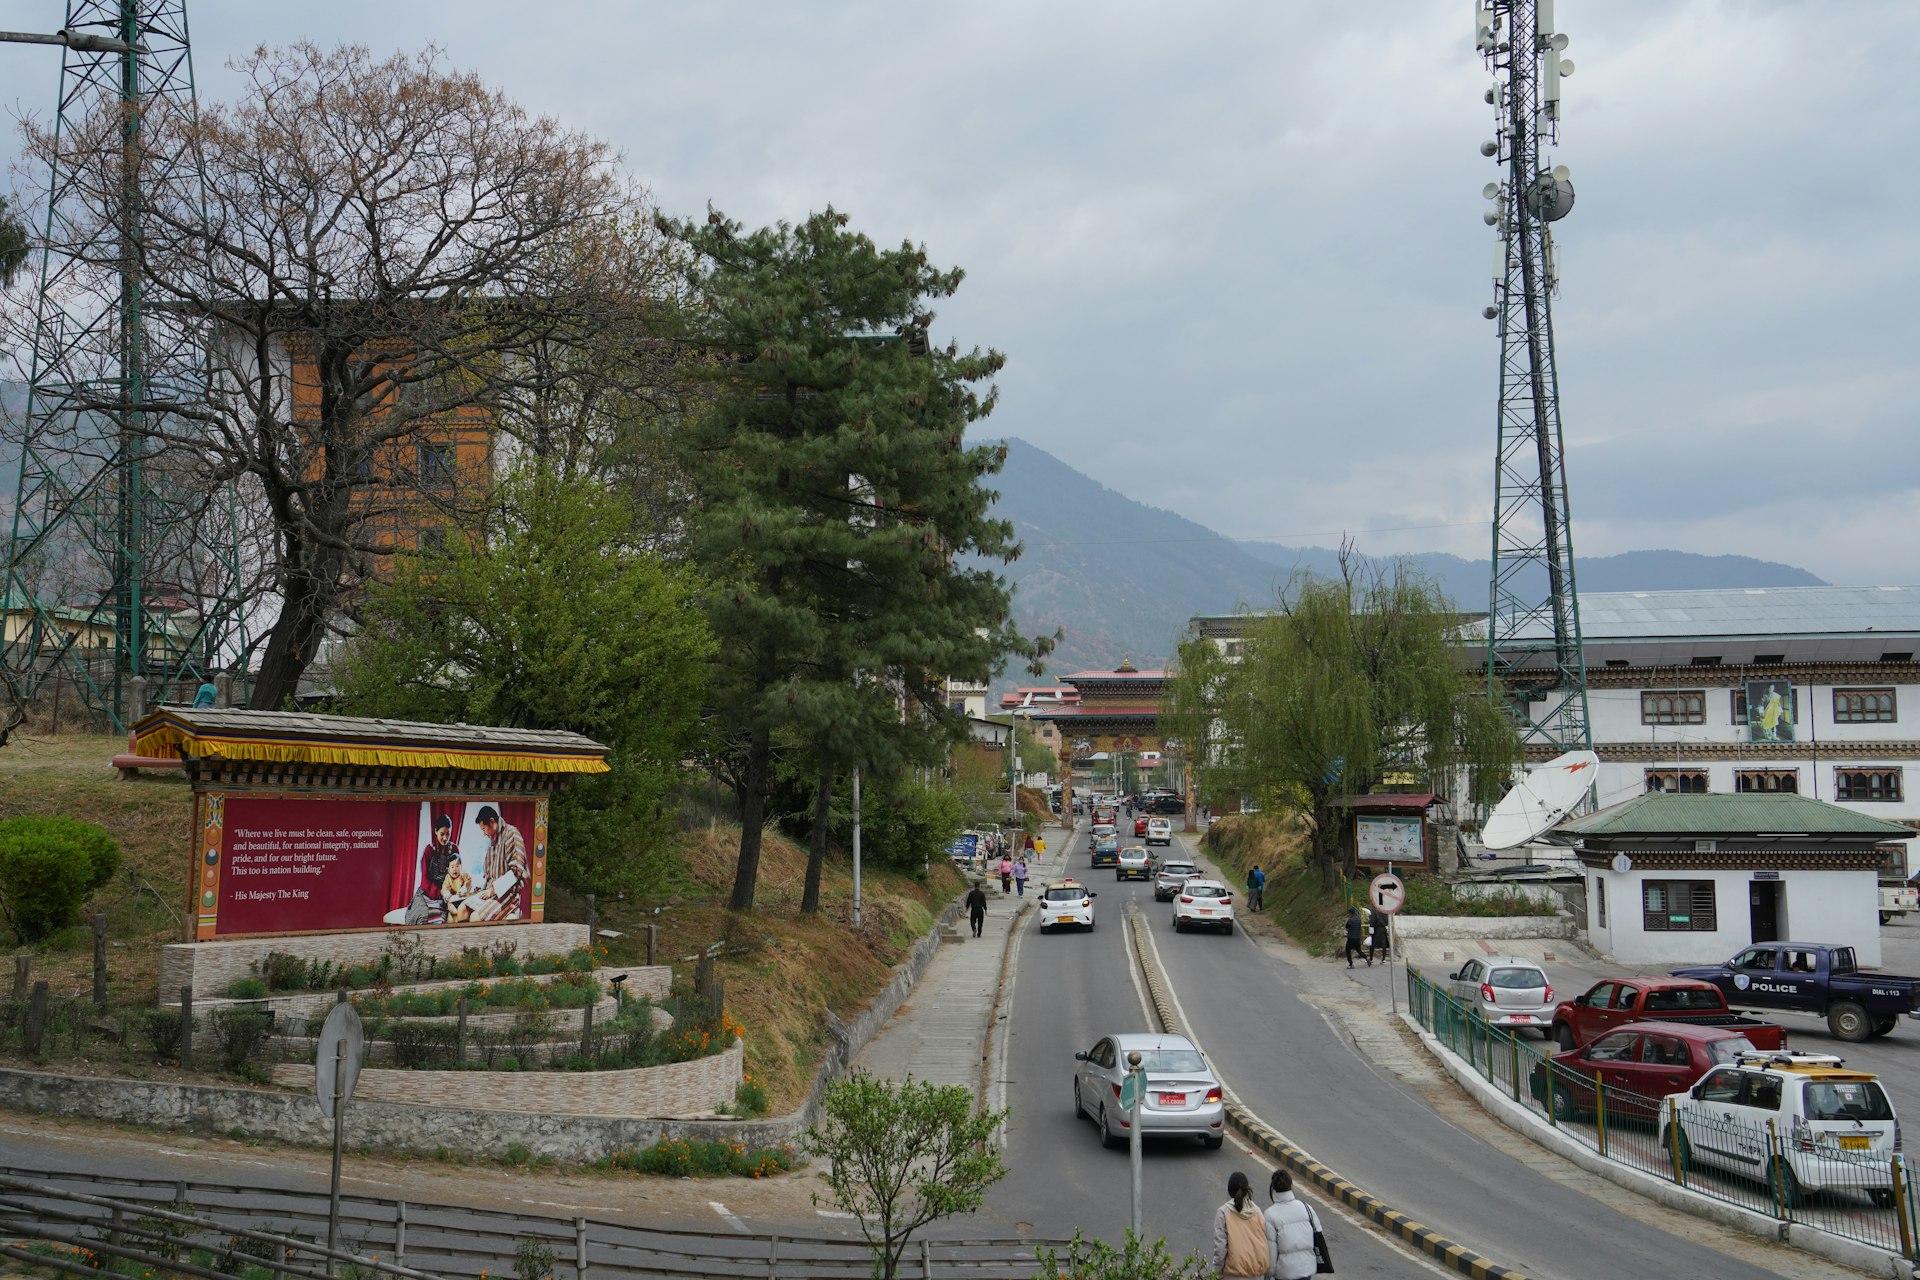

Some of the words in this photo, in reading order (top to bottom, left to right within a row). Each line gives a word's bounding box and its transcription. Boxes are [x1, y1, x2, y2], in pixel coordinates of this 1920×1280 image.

[275, 829, 287, 837] live
[306, 829, 315, 837] be
[336, 829, 350, 837] safe,
[233, 842, 246, 850] and
[249, 841, 281, 850] beautiful,
[282, 841, 292, 849] for
[294, 841, 321, 849] national
[323, 841, 352, 851] integrity,
[232, 854, 253, 864] pride,
[254, 854, 268, 862] and
[294, 853, 314, 863] bright
[316, 853, 337, 861] future.
[232, 866, 247, 875] This
[262, 866, 268, 874] is
[270, 866, 291, 874] nation
[249, 891, 276, 901] Majesty
[278, 890, 291, 898] The
[292, 889, 309, 899] King
[1751, 983, 1797, 993] POLICE
[1872, 988, 1885, 996] DIAL
